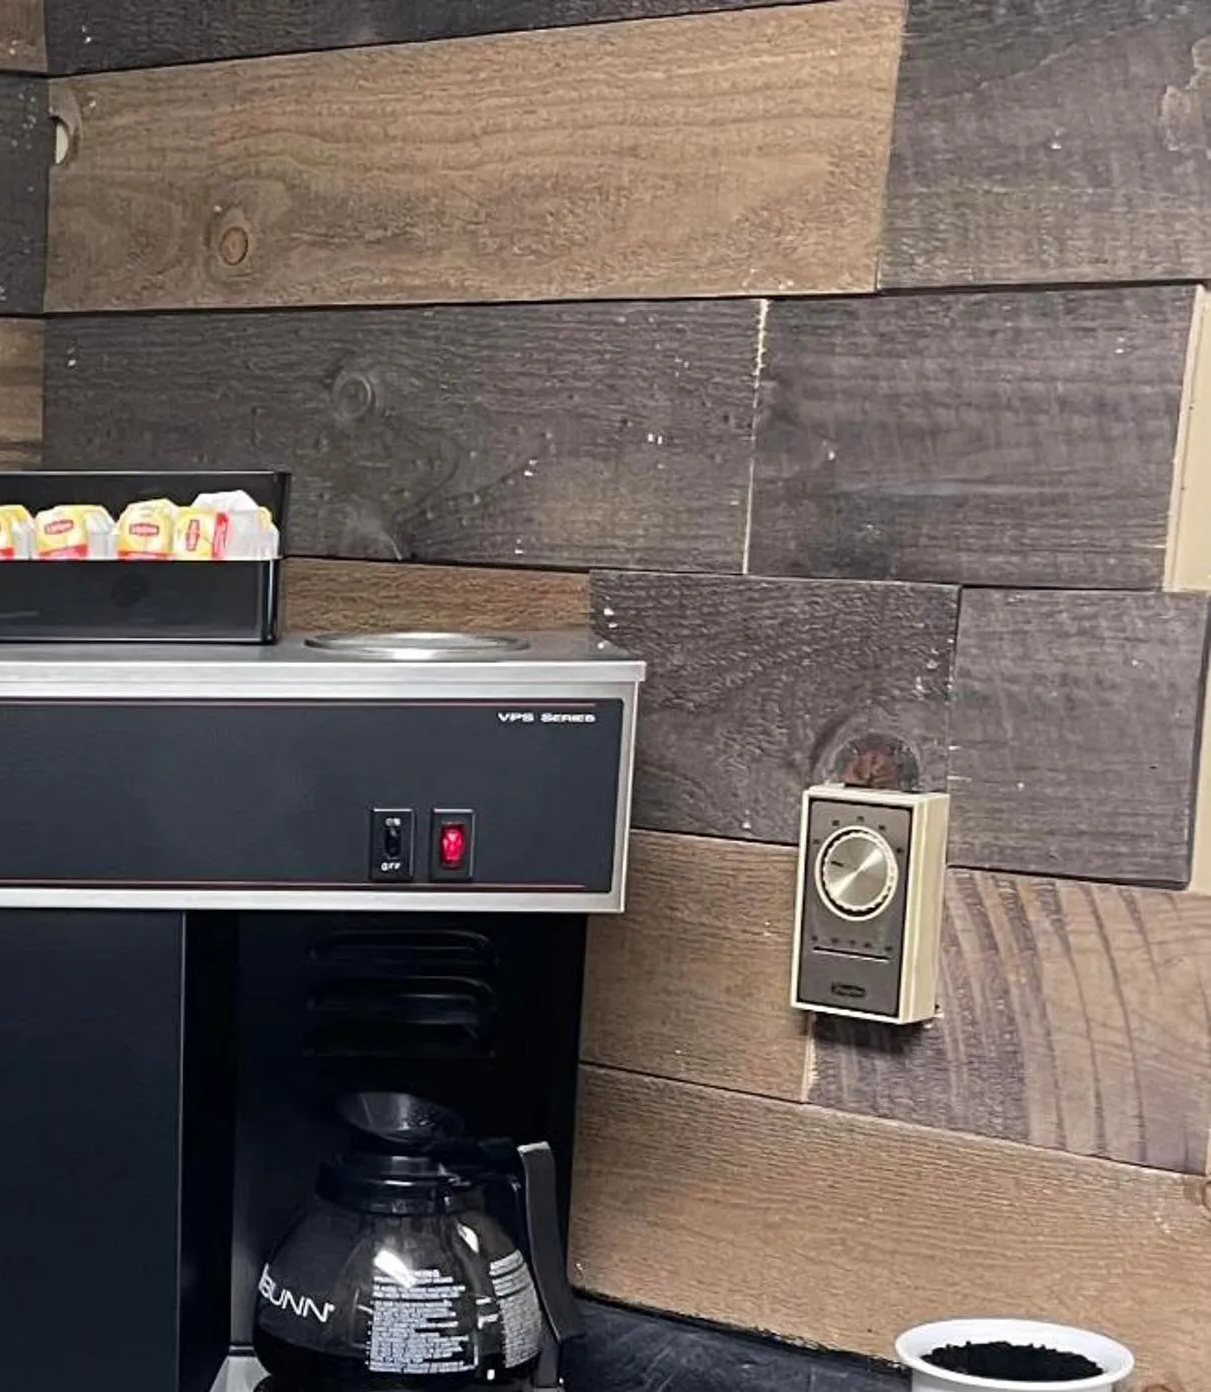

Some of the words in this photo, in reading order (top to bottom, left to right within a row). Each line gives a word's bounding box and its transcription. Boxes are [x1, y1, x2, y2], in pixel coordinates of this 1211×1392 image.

[497, 712, 535, 722] VPS
[380, 862, 401, 872] OFF
[258, 1263, 335, 1322] BUNN
